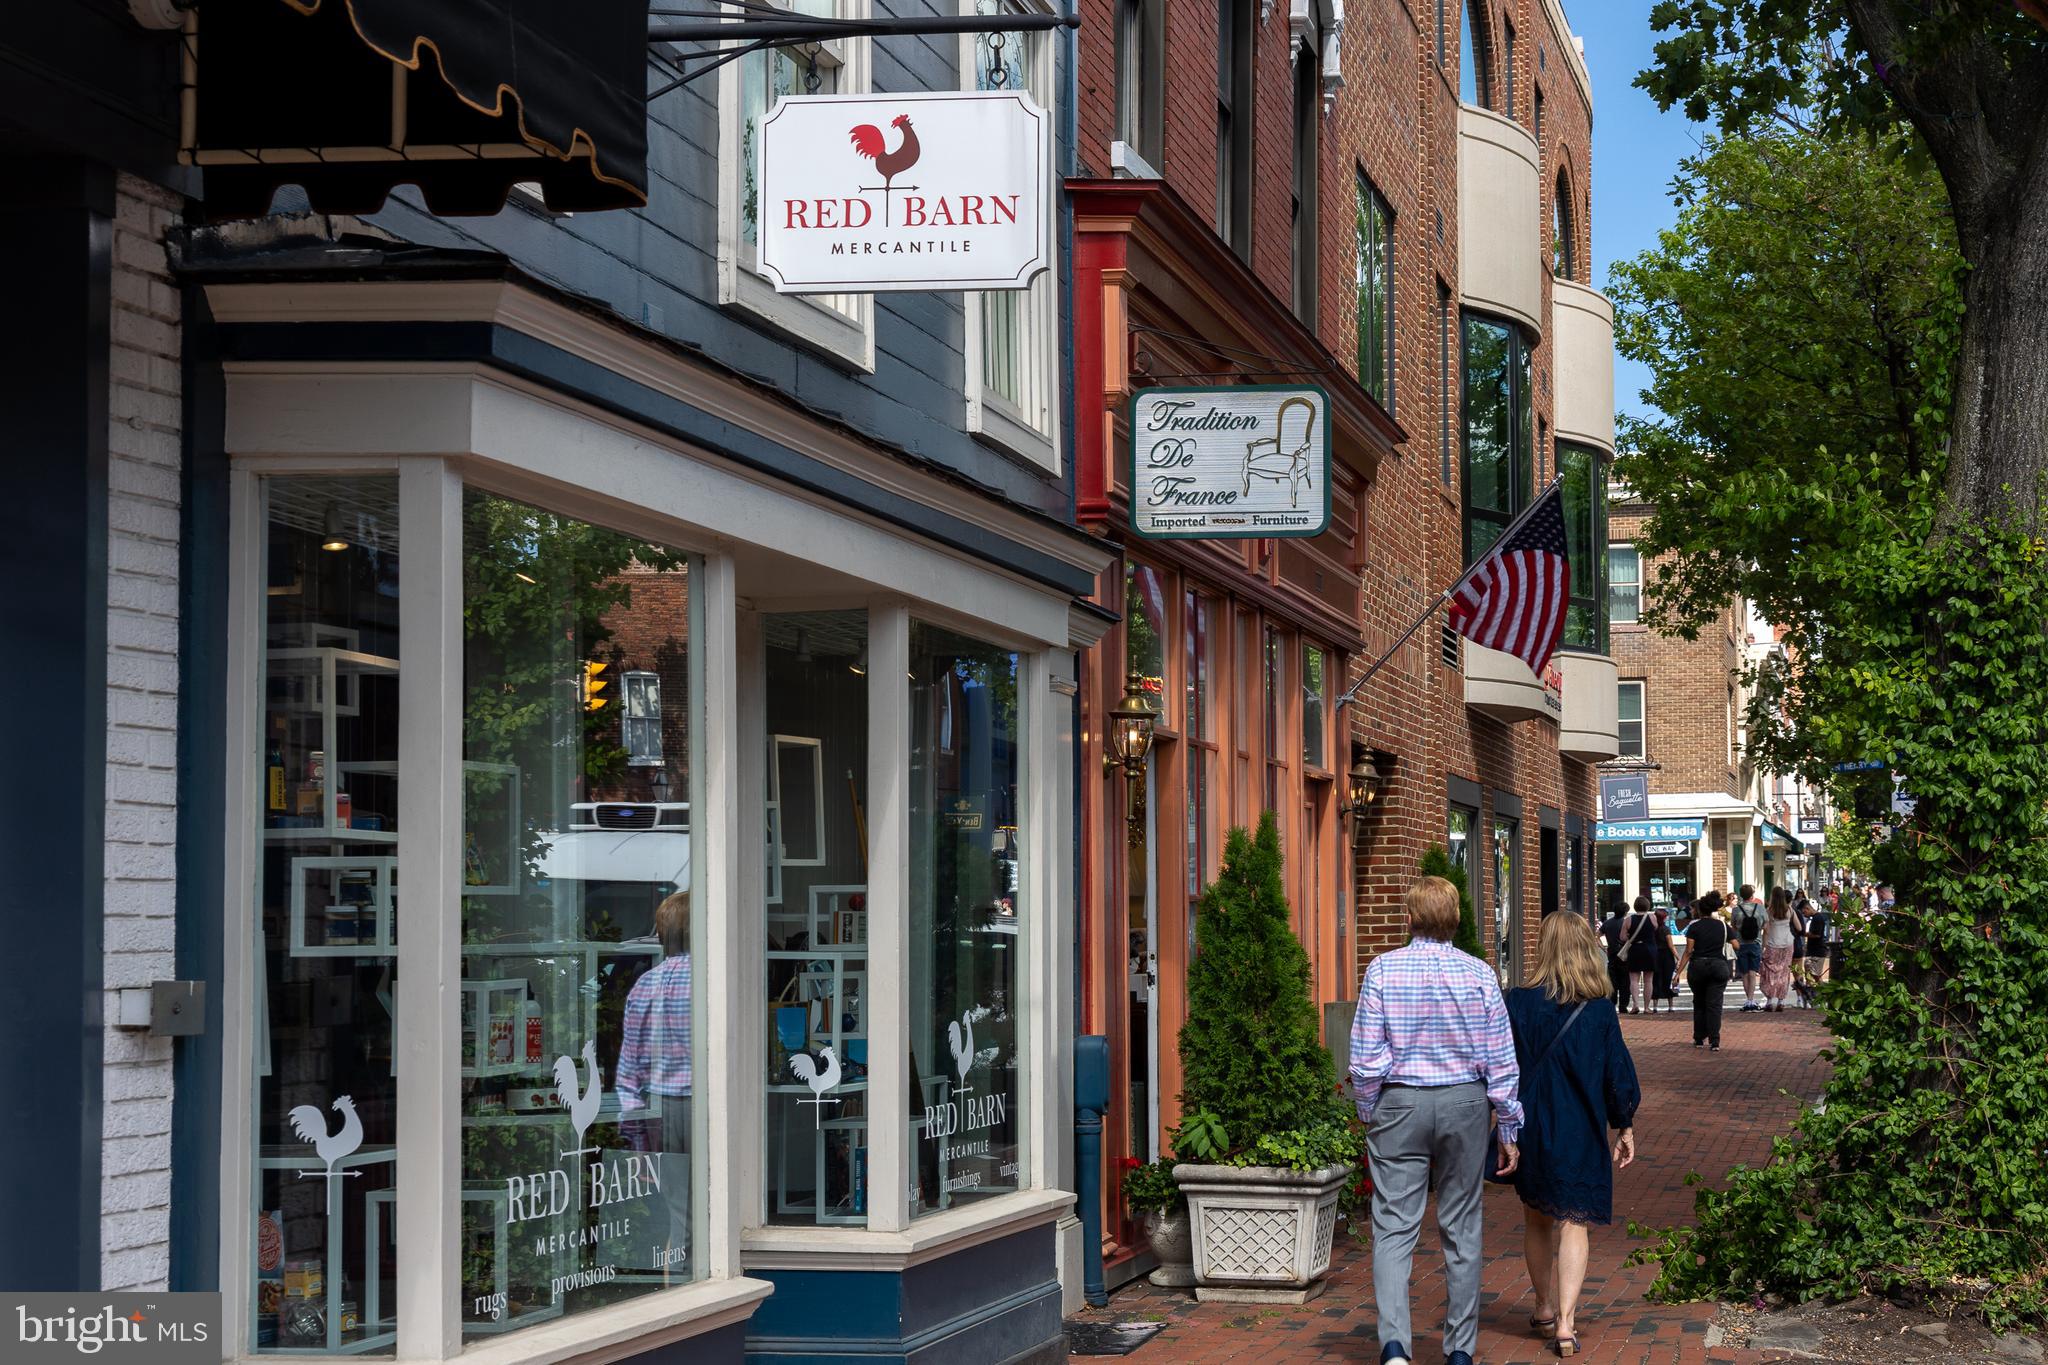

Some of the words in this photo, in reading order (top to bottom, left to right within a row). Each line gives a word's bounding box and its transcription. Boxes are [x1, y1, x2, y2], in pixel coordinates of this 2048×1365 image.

[783, 198, 872, 229] RED
[902, 195, 1020, 227] BARN
[831, 240, 971, 255] MERCANTILE
[1147, 400, 1260, 432] Tradition
[1147, 438, 1197, 468] De
[1147, 475, 1238, 506] France
[1151, 515, 1206, 529] Imported
[1252, 514, 1309, 526] Furniture
[1607, 793, 1643, 808] Baguette
[1607, 826, 1646, 837] Books
[1649, 826, 1659, 837] &
[1661, 825, 1698, 837] Media
[1647, 845, 1660, 853] ONE
[1650, 877, 1664, 885] Gifts
[1668, 877, 1686, 886] Chapel
[924, 1102, 958, 1140] RED
[967, 1092, 1007, 1131] BARN
[939, 1139, 989, 1162] MERCANTILE
[506, 1169, 570, 1224] RED
[589, 1152, 663, 1208] BARN
[908, 1183, 921, 1206] lay
[942, 1168, 981, 1193] furnishings
[1000, 1160, 1020, 1180] vintag
[535, 1218, 631, 1257] MERCANTILE
[474, 1290, 507, 1320] rugs
[551, 1261, 616, 1304] provisions
[652, 1245, 687, 1269] linens
